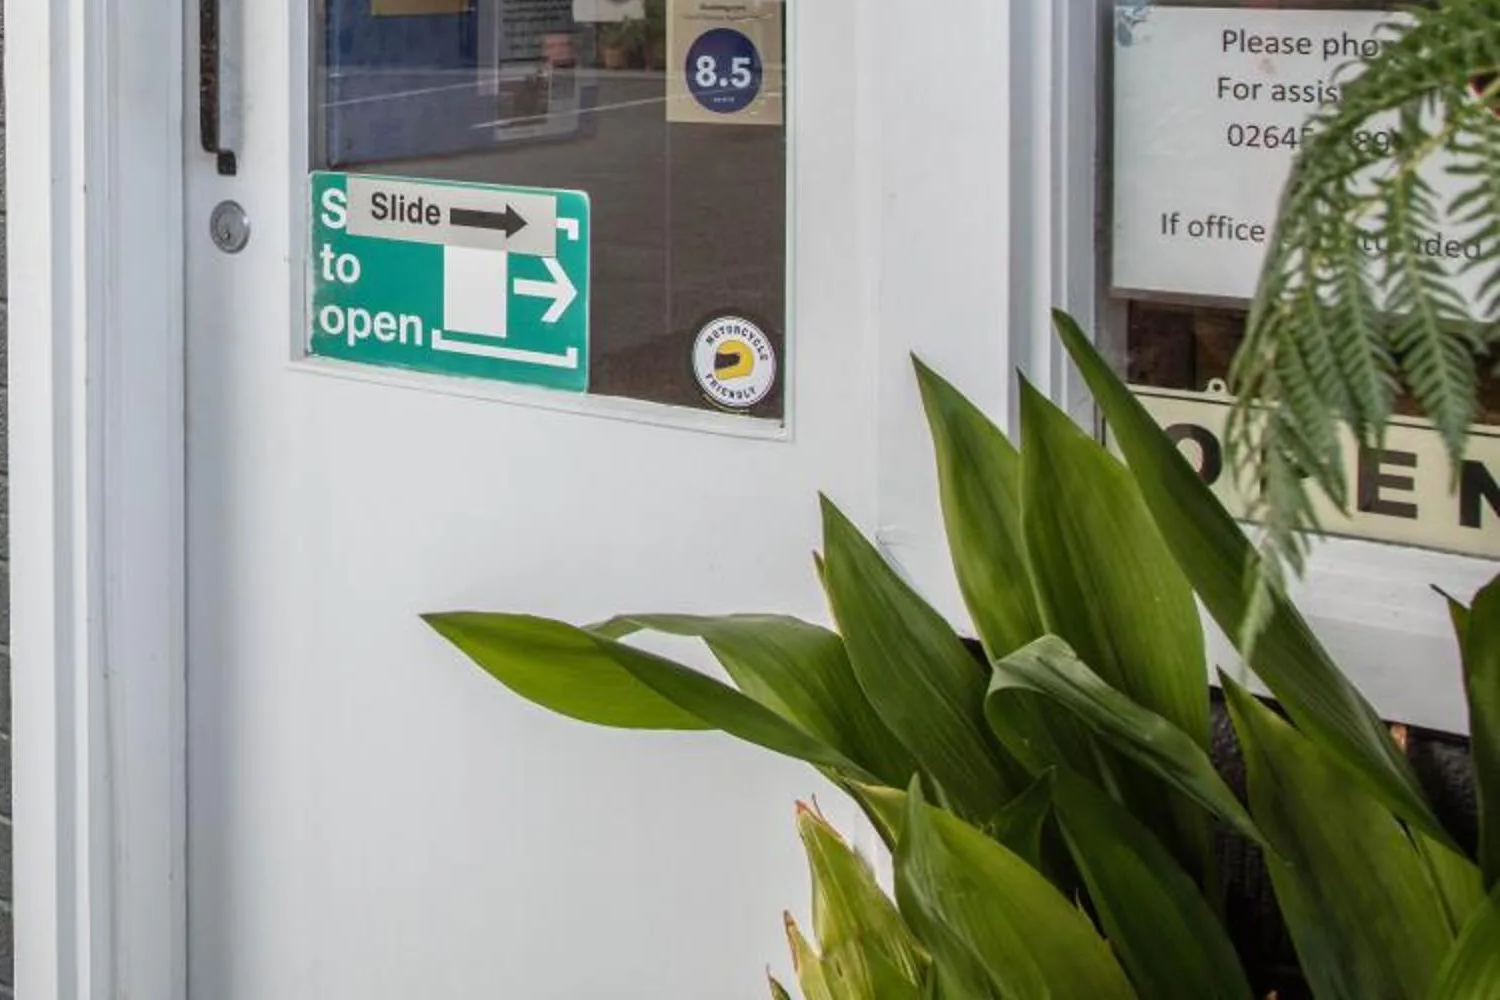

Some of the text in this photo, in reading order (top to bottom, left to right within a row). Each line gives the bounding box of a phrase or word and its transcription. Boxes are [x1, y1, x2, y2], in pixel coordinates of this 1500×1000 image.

[1223, 29, 1380, 62] Please pho
[696, 55, 752, 89] 8.5
[1217, 77, 1263, 101] For
[371, 191, 442, 226] Slide
[1160, 212, 1179, 237] If
[1187, 213, 1267, 243] office
[320, 243, 361, 284] to
[319, 304, 423, 347] open
[1162, 423, 1500, 530] OEN
